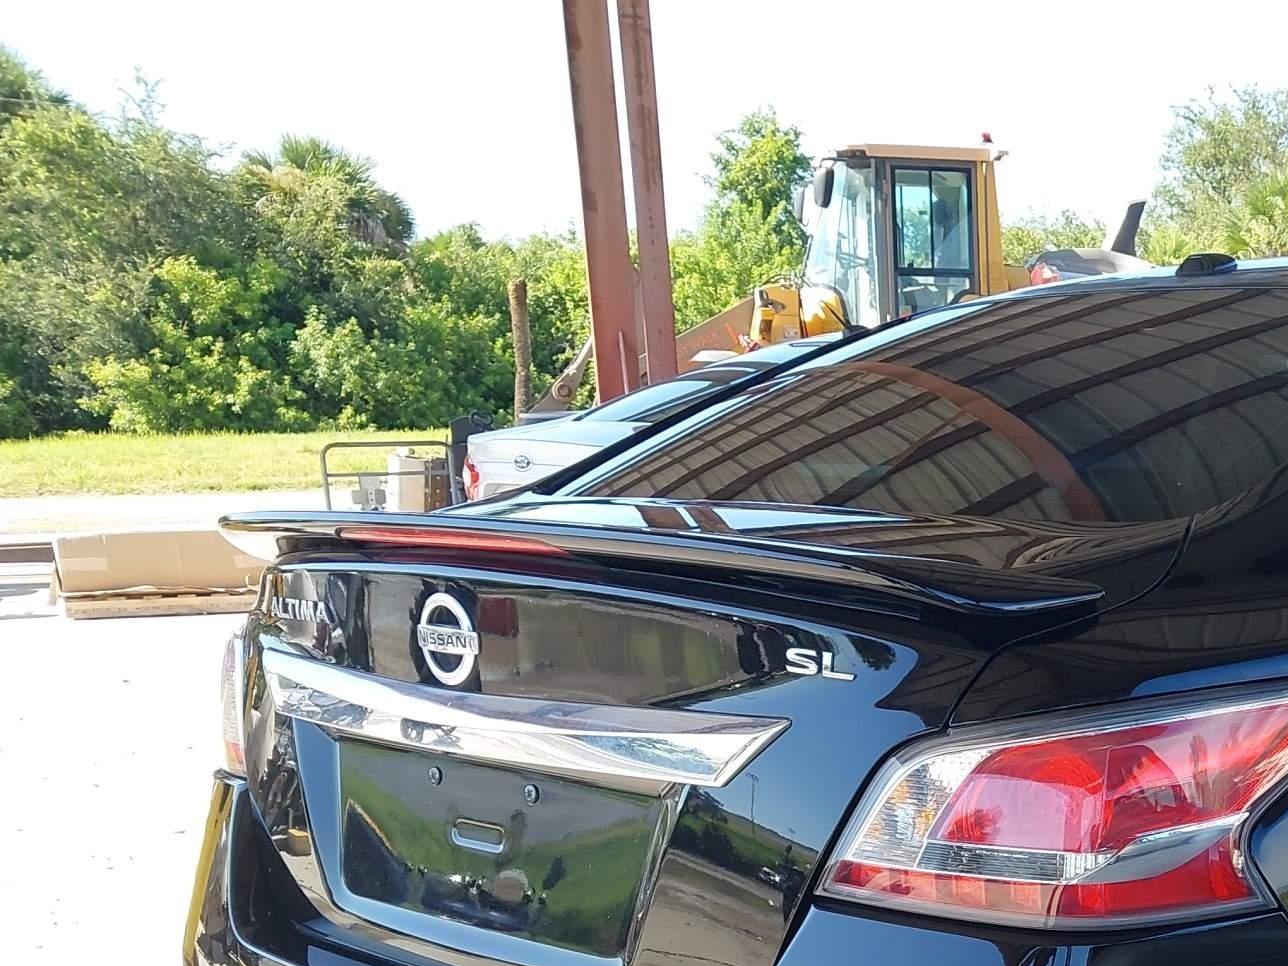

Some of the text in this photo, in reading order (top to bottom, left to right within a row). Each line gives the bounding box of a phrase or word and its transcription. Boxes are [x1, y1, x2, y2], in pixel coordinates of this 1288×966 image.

[270, 596, 330, 624] ALTIMA
[419, 629, 467, 649] NISSAN
[785, 647, 857, 681] SL
